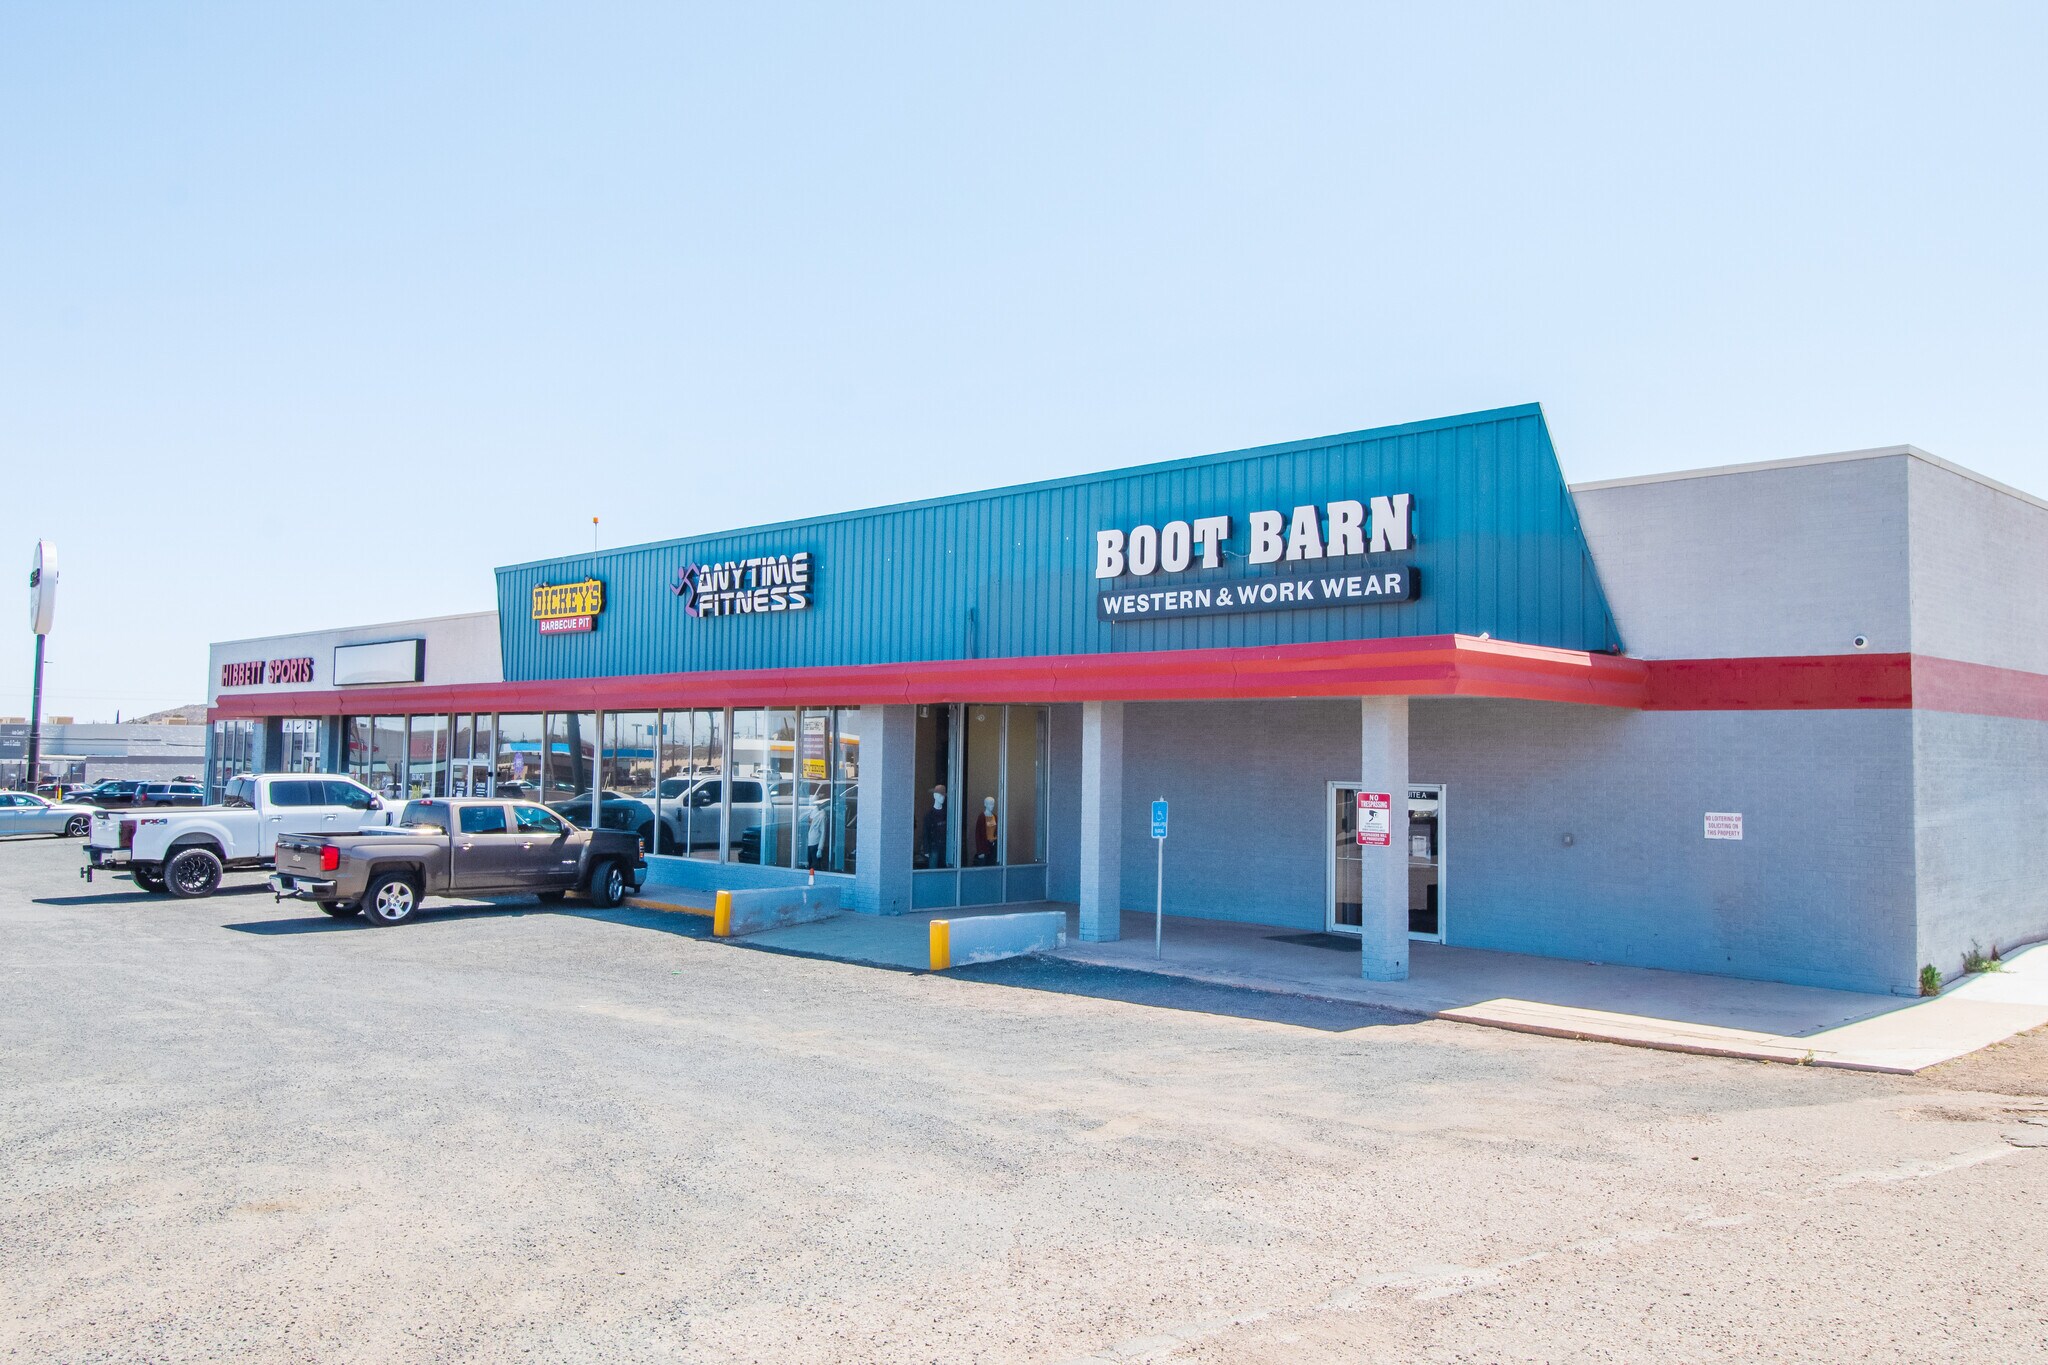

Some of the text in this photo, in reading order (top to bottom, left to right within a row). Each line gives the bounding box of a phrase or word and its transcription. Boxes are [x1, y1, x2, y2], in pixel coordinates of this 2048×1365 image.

[1095, 493, 1411, 579] BOOT BARN
[697, 552, 809, 593] ANYTIME
[534, 584, 600, 616] DICKEY'S
[699, 585, 808, 618] FITNESS
[1103, 573, 1402, 614] WESTERN & WORK WEAR
[541, 617, 590, 631] BARBECUE PIT
[222, 658, 313, 687] HIBBETT SPORTS
[1360, 800, 1388, 808] TRESPASSING
[1408, 791, 1421, 799] UITE
[140, 818, 168, 826] FX4
